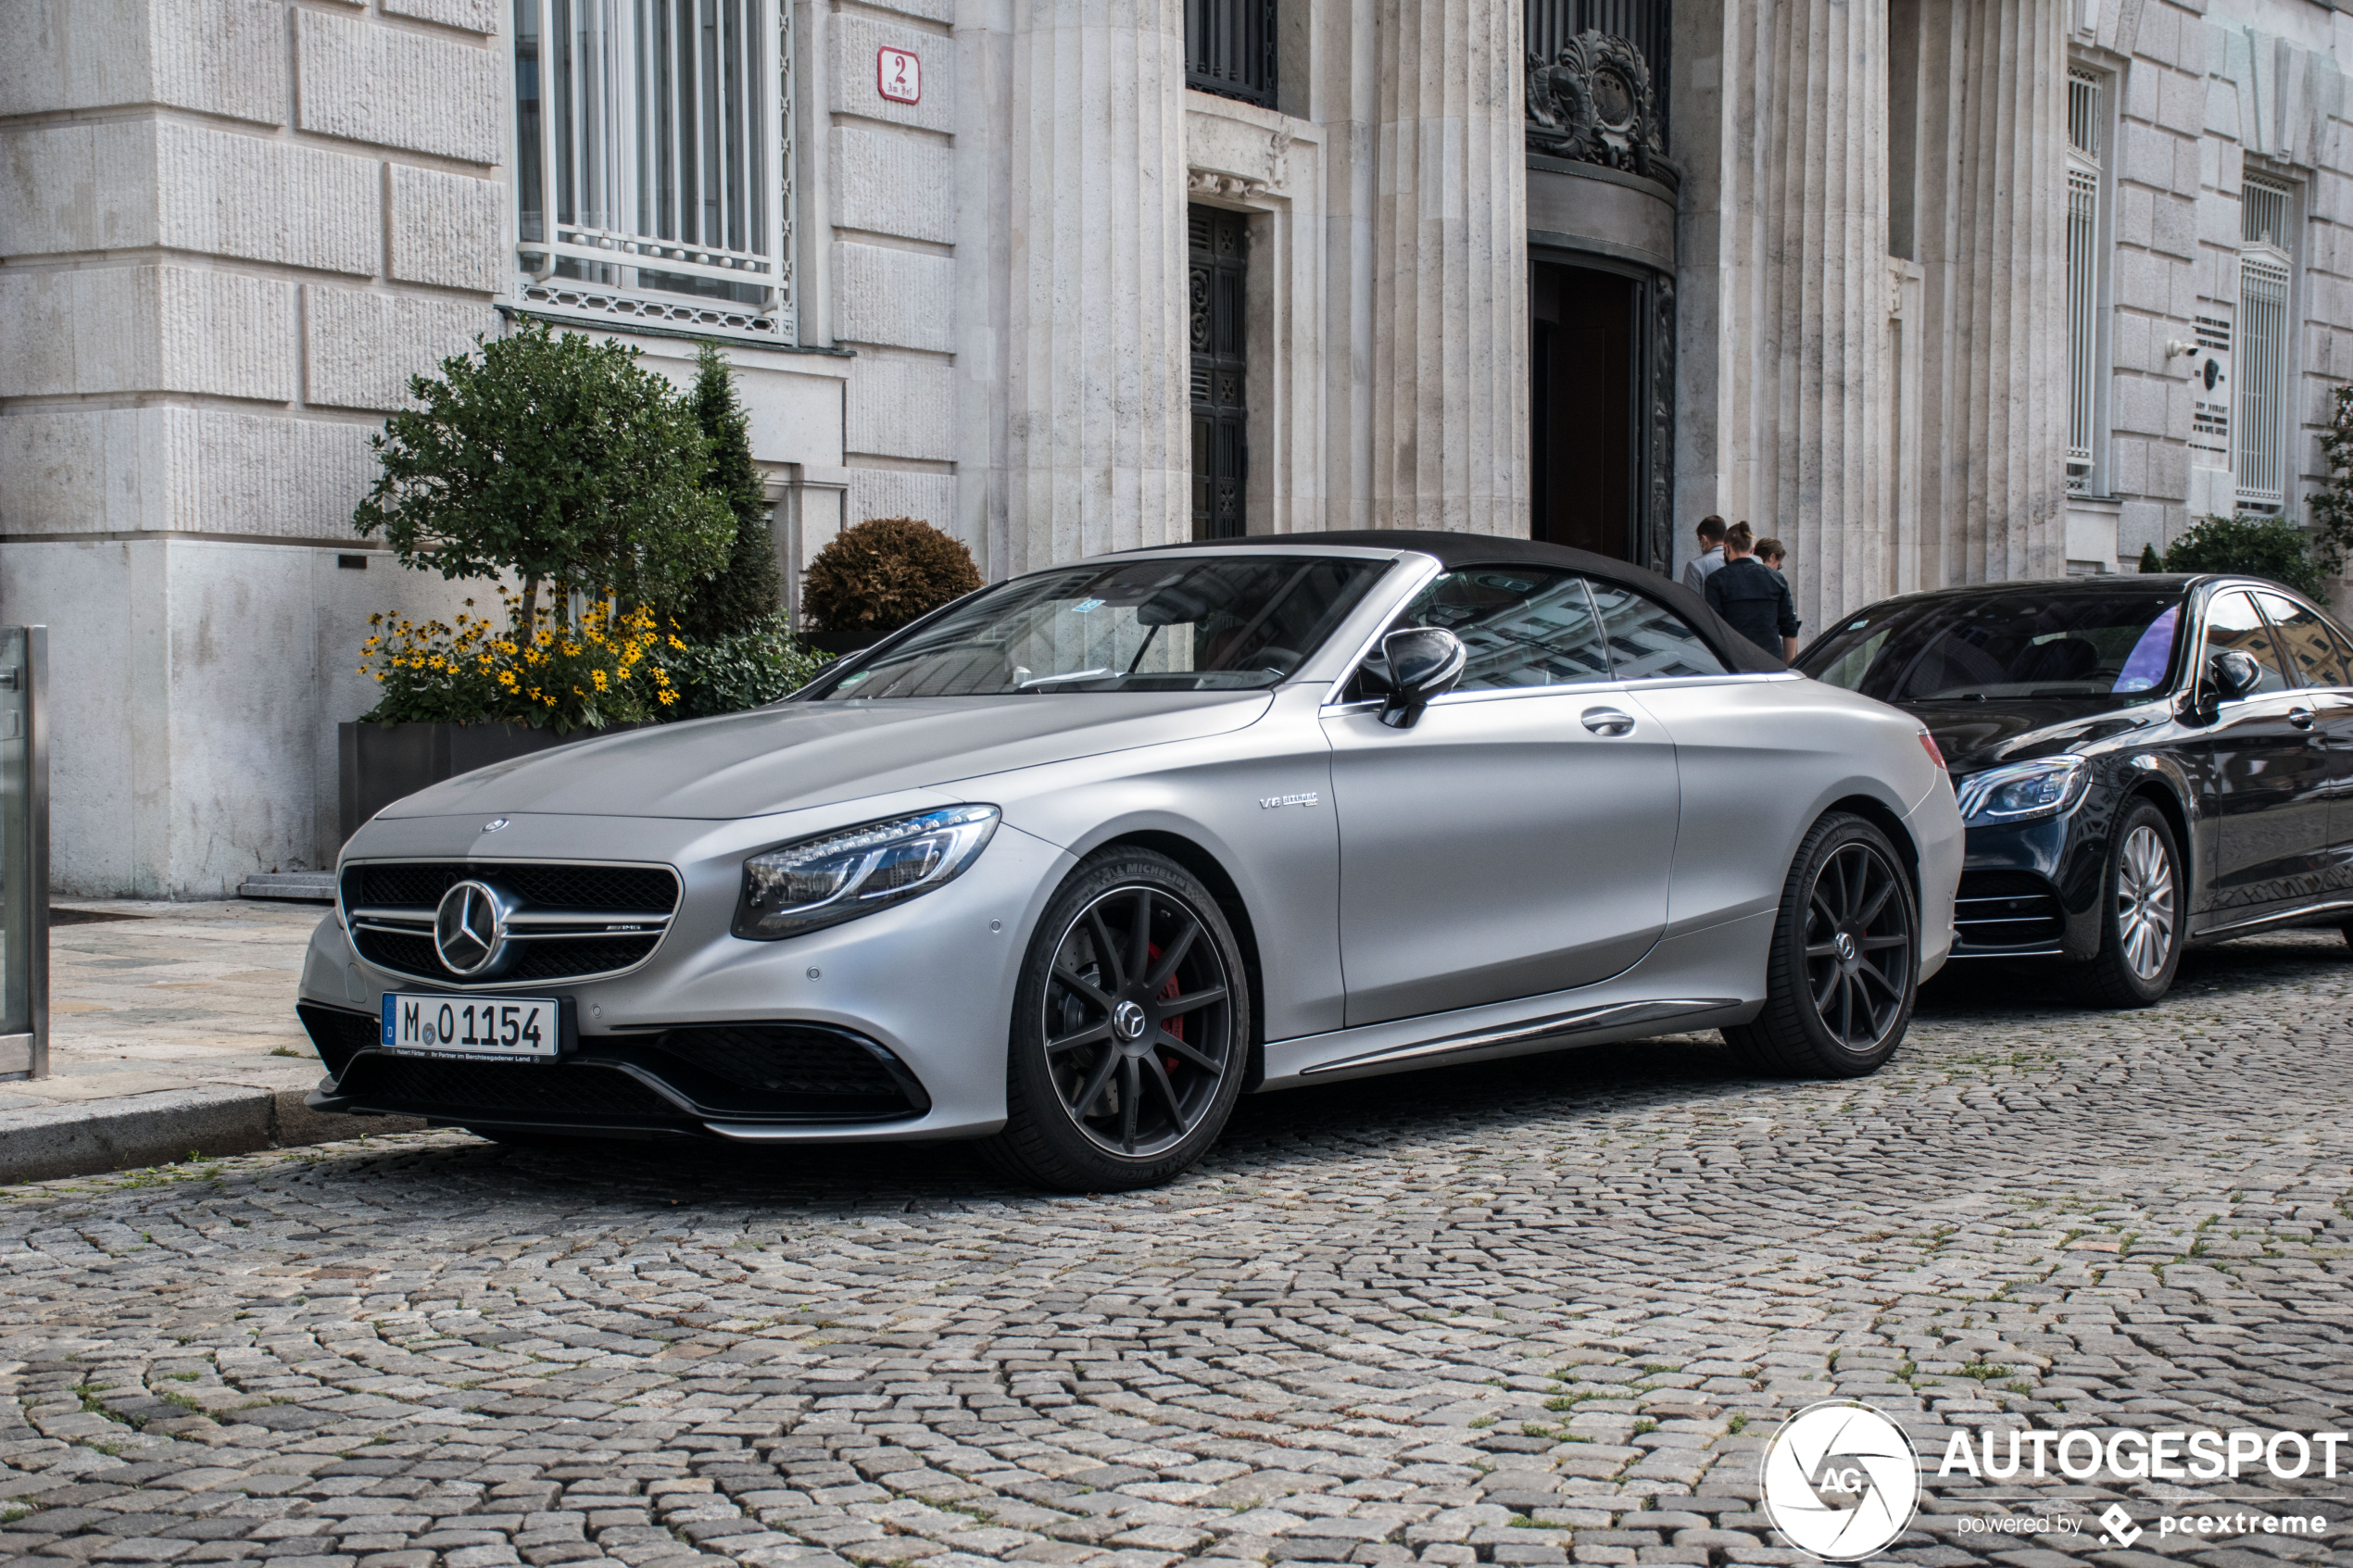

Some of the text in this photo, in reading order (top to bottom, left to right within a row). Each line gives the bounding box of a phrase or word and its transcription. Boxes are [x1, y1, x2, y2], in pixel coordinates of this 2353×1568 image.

[895, 56, 906, 84] 2
[888, 82, 912, 97] Am Hof
[1126, 863, 1187, 888] MICHELIN
[386, 1026, 393, 1038] D
[404, 1001, 420, 1042] M
[461, 1005, 542, 1047] 1154
[465, 1053, 514, 1062] Berchtesgadener
[1088, 1156, 1154, 1179] MICHELIN
